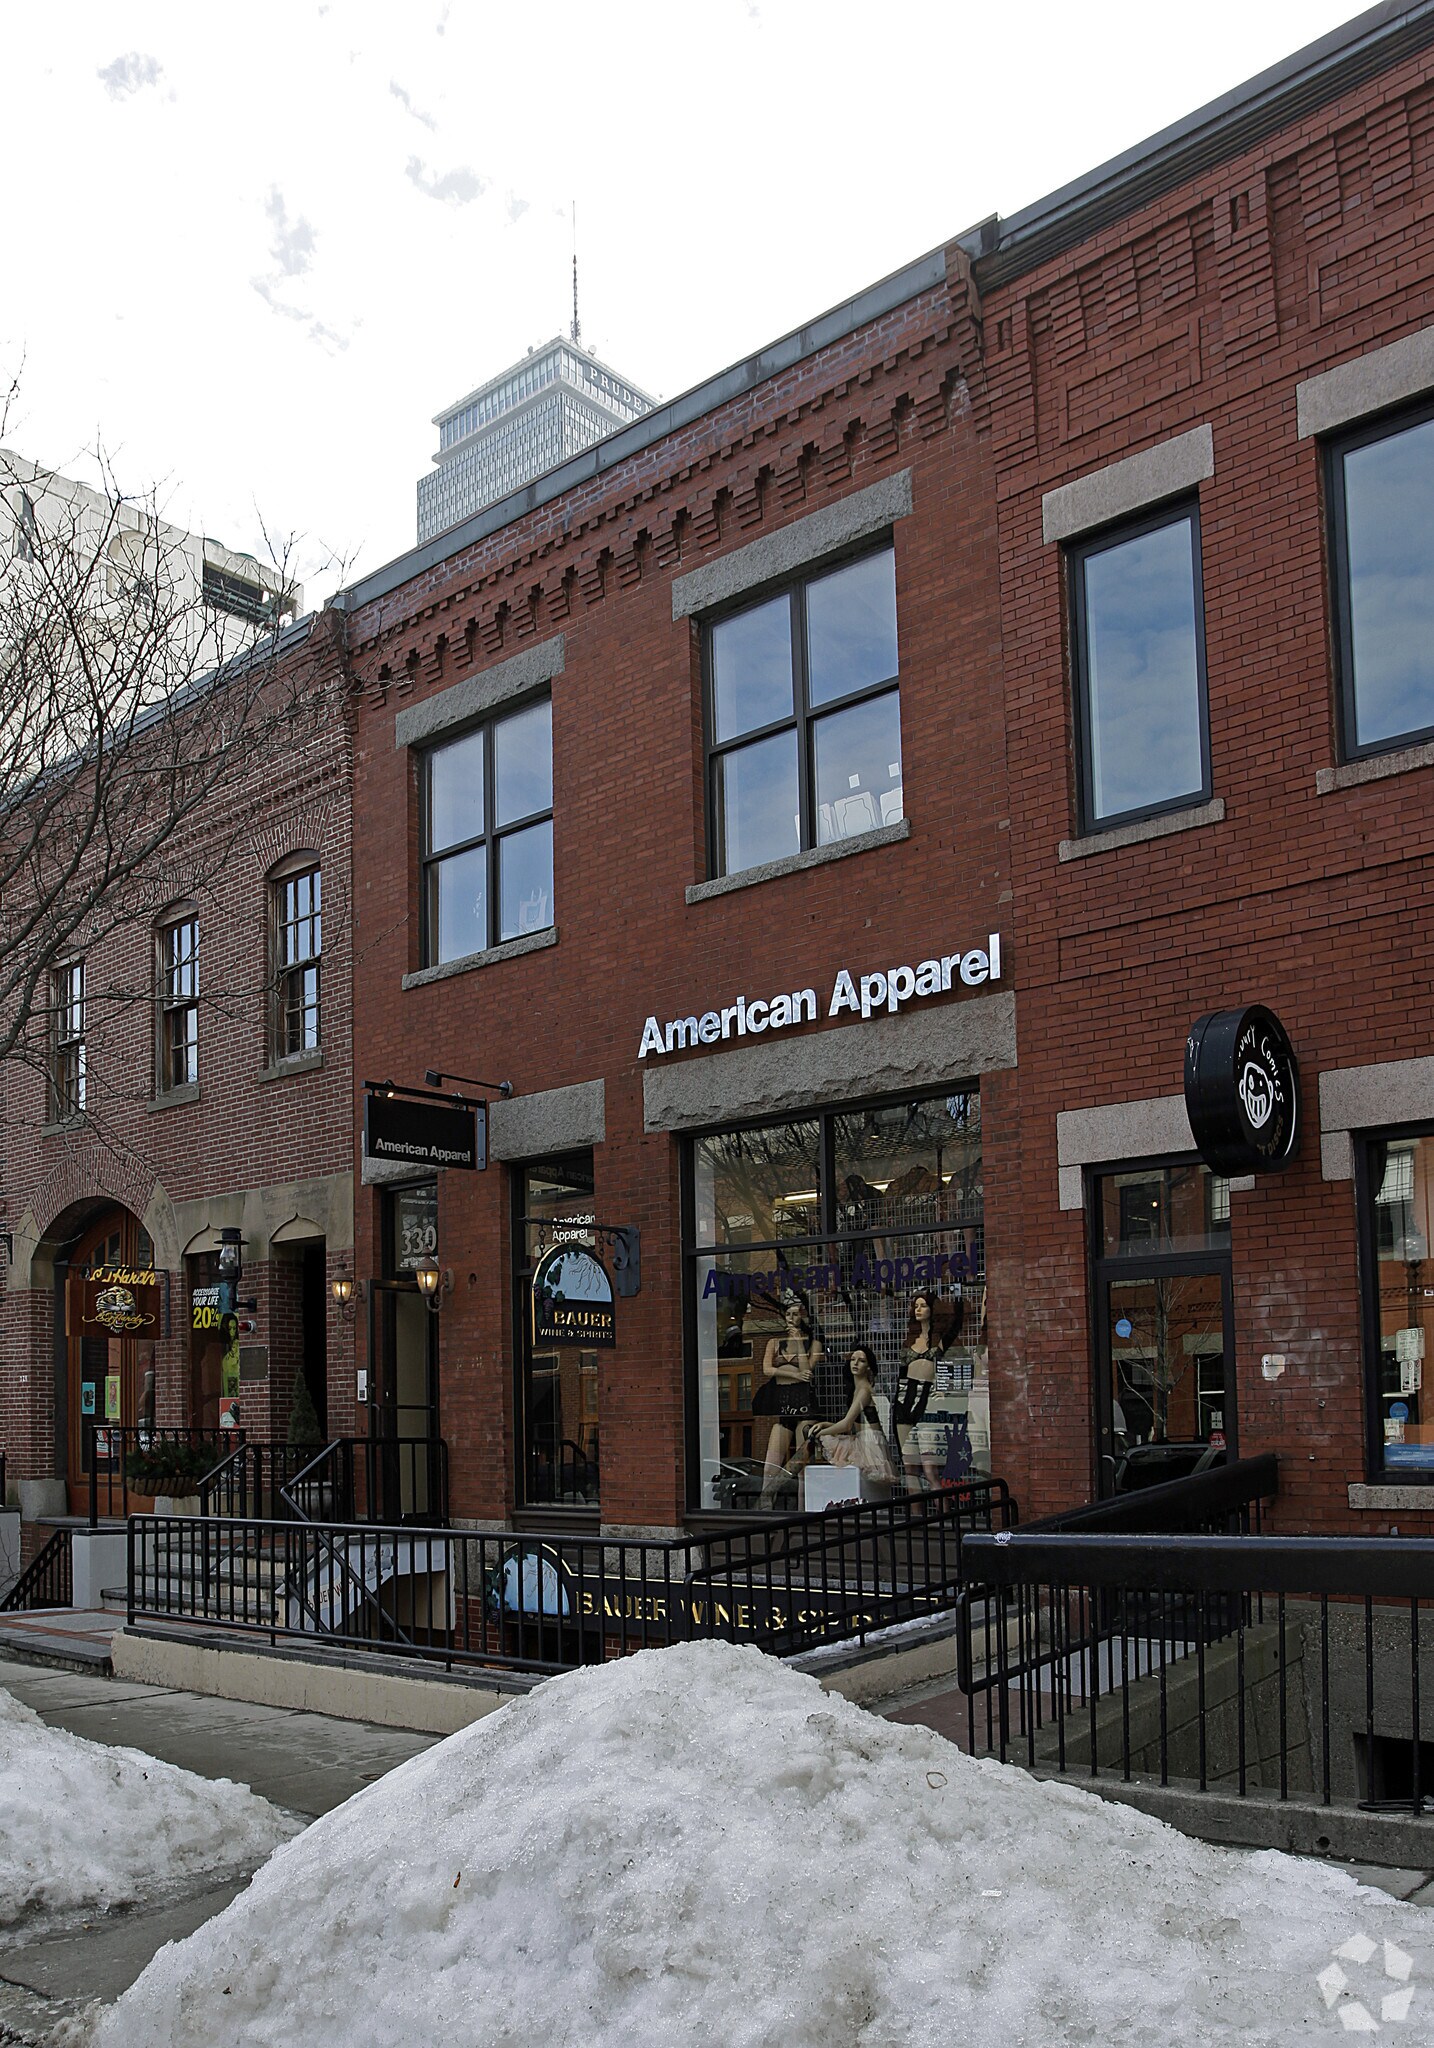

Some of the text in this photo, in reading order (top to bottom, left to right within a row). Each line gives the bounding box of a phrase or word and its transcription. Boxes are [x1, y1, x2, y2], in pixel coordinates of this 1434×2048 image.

[638, 932, 1001, 1059] American Apparel
[375, 1138, 471, 1162] American Apparel
[402, 1226, 437, 1255] 330
[552, 1229, 588, 1242] Apparel
[702, 1243, 978, 1299] American Apparel
[192, 1295, 219, 1306] YOUR LIFE
[193, 1306, 220, 1329] 20%
[554, 1311, 612, 1327] BAUER
[540, 1328, 613, 1339] WINE & SPIRITS
[575, 1591, 673, 1622] BAUER
[766, 1606, 787, 1631] &
